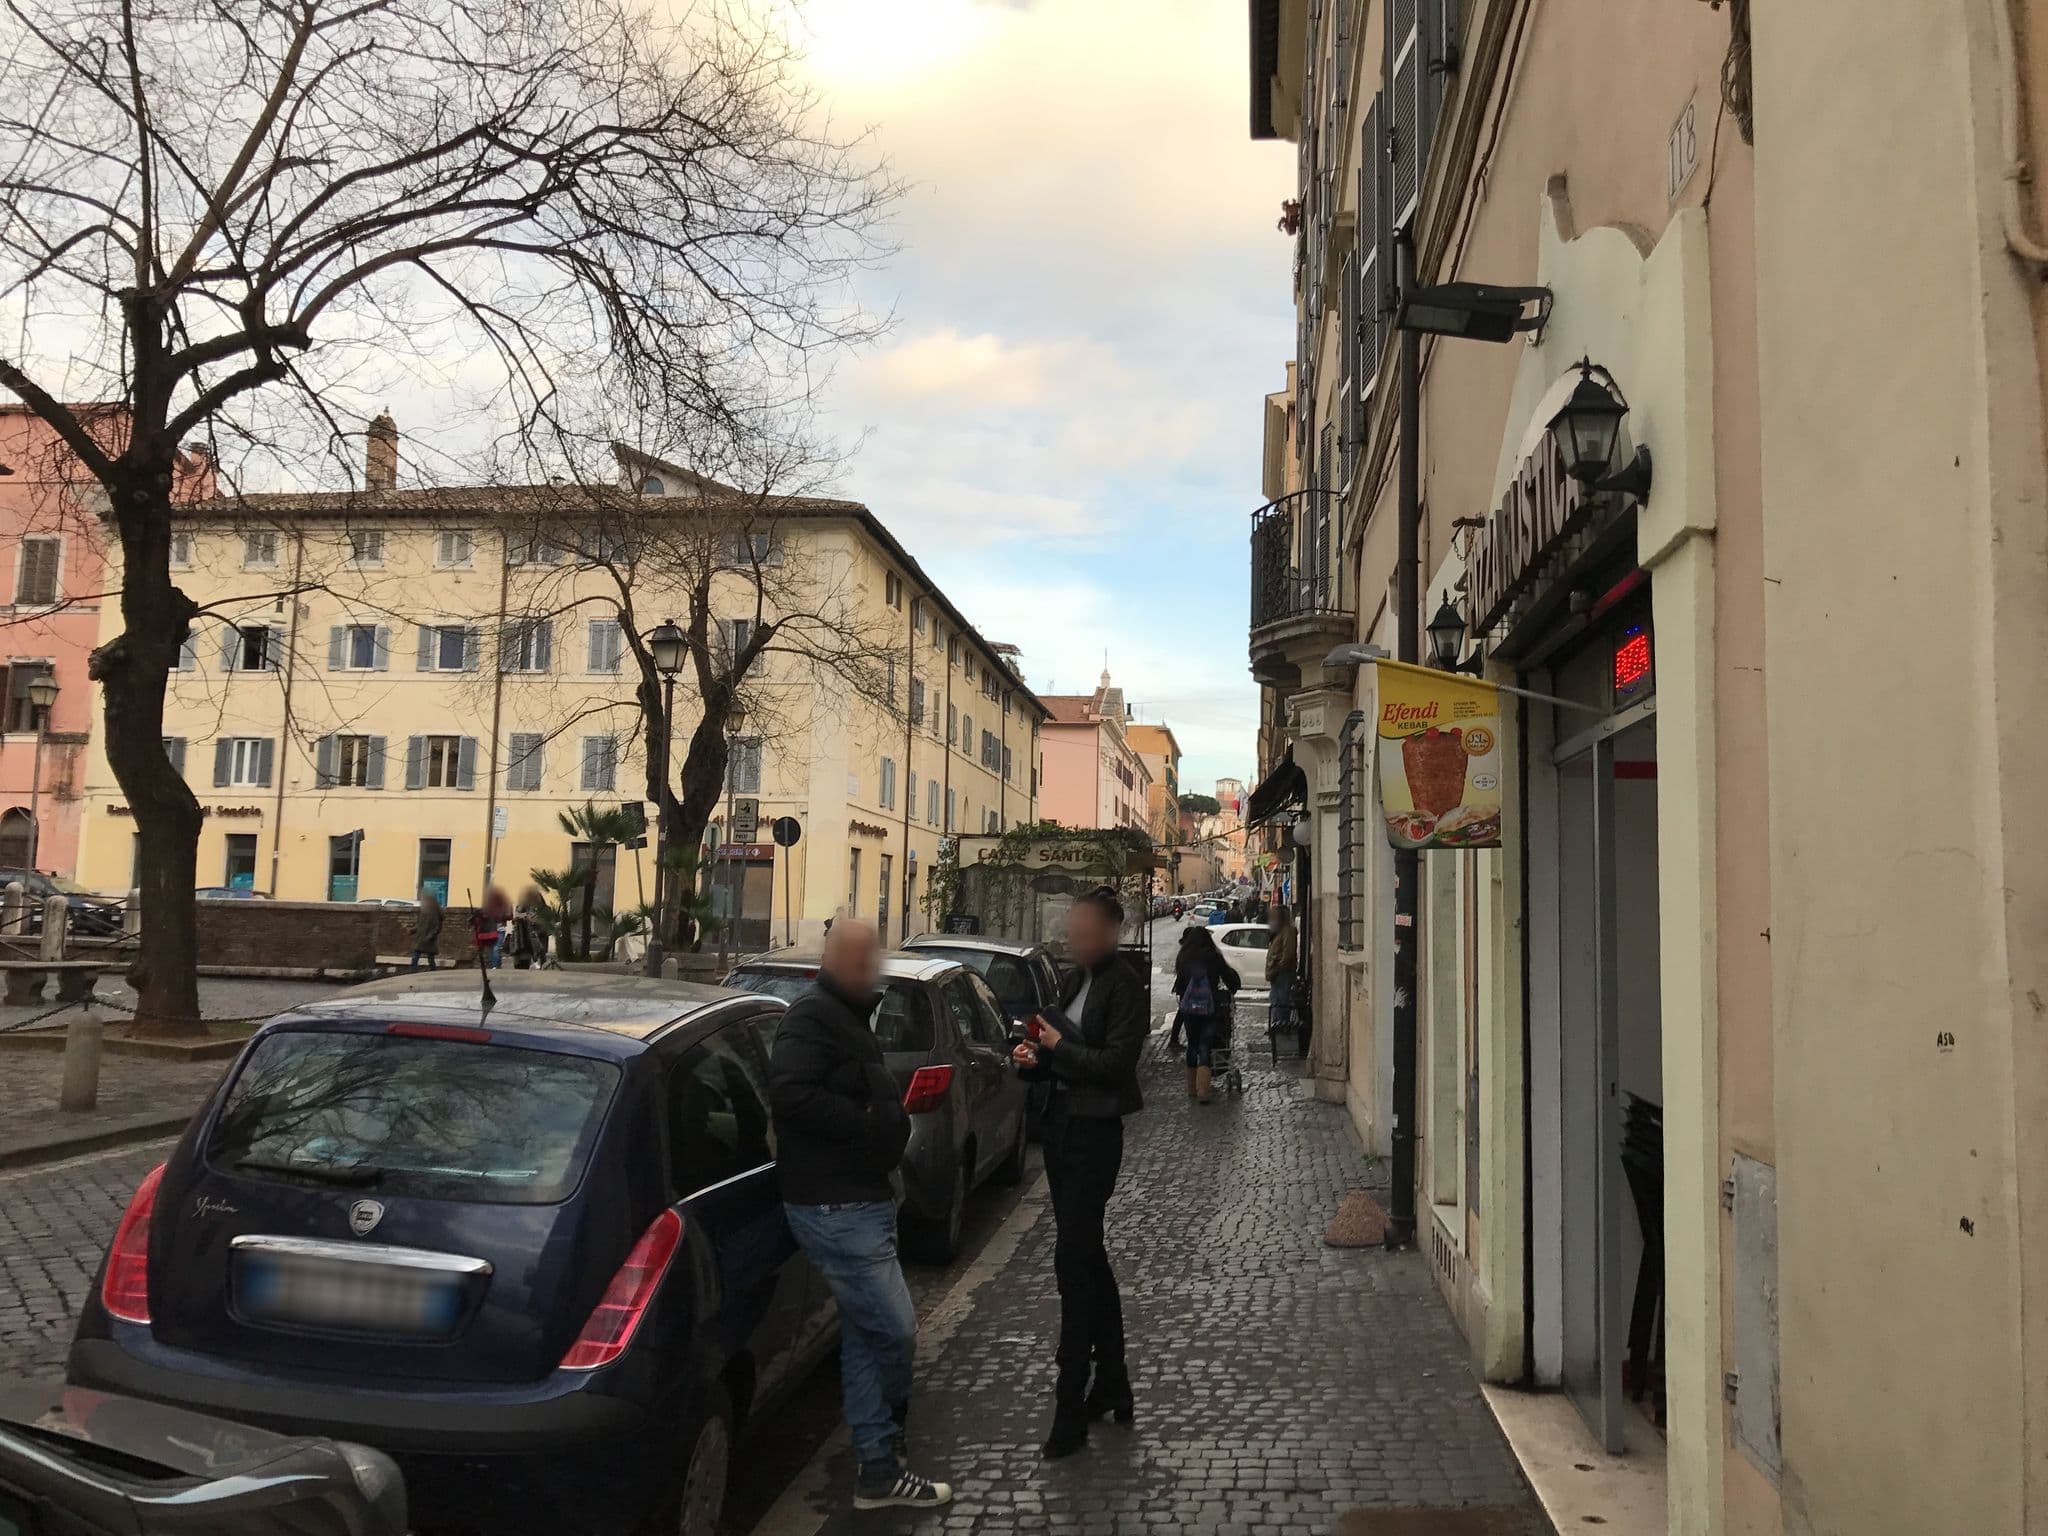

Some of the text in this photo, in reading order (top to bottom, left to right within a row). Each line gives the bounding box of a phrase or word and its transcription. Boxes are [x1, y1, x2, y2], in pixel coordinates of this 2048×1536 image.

[1670, 104, 1696, 196] 118
[1381, 701, 1439, 724] Efendi
[1397, 721, 1429, 730] KEBAB
[1040, 849, 1104, 862] SANTOS
